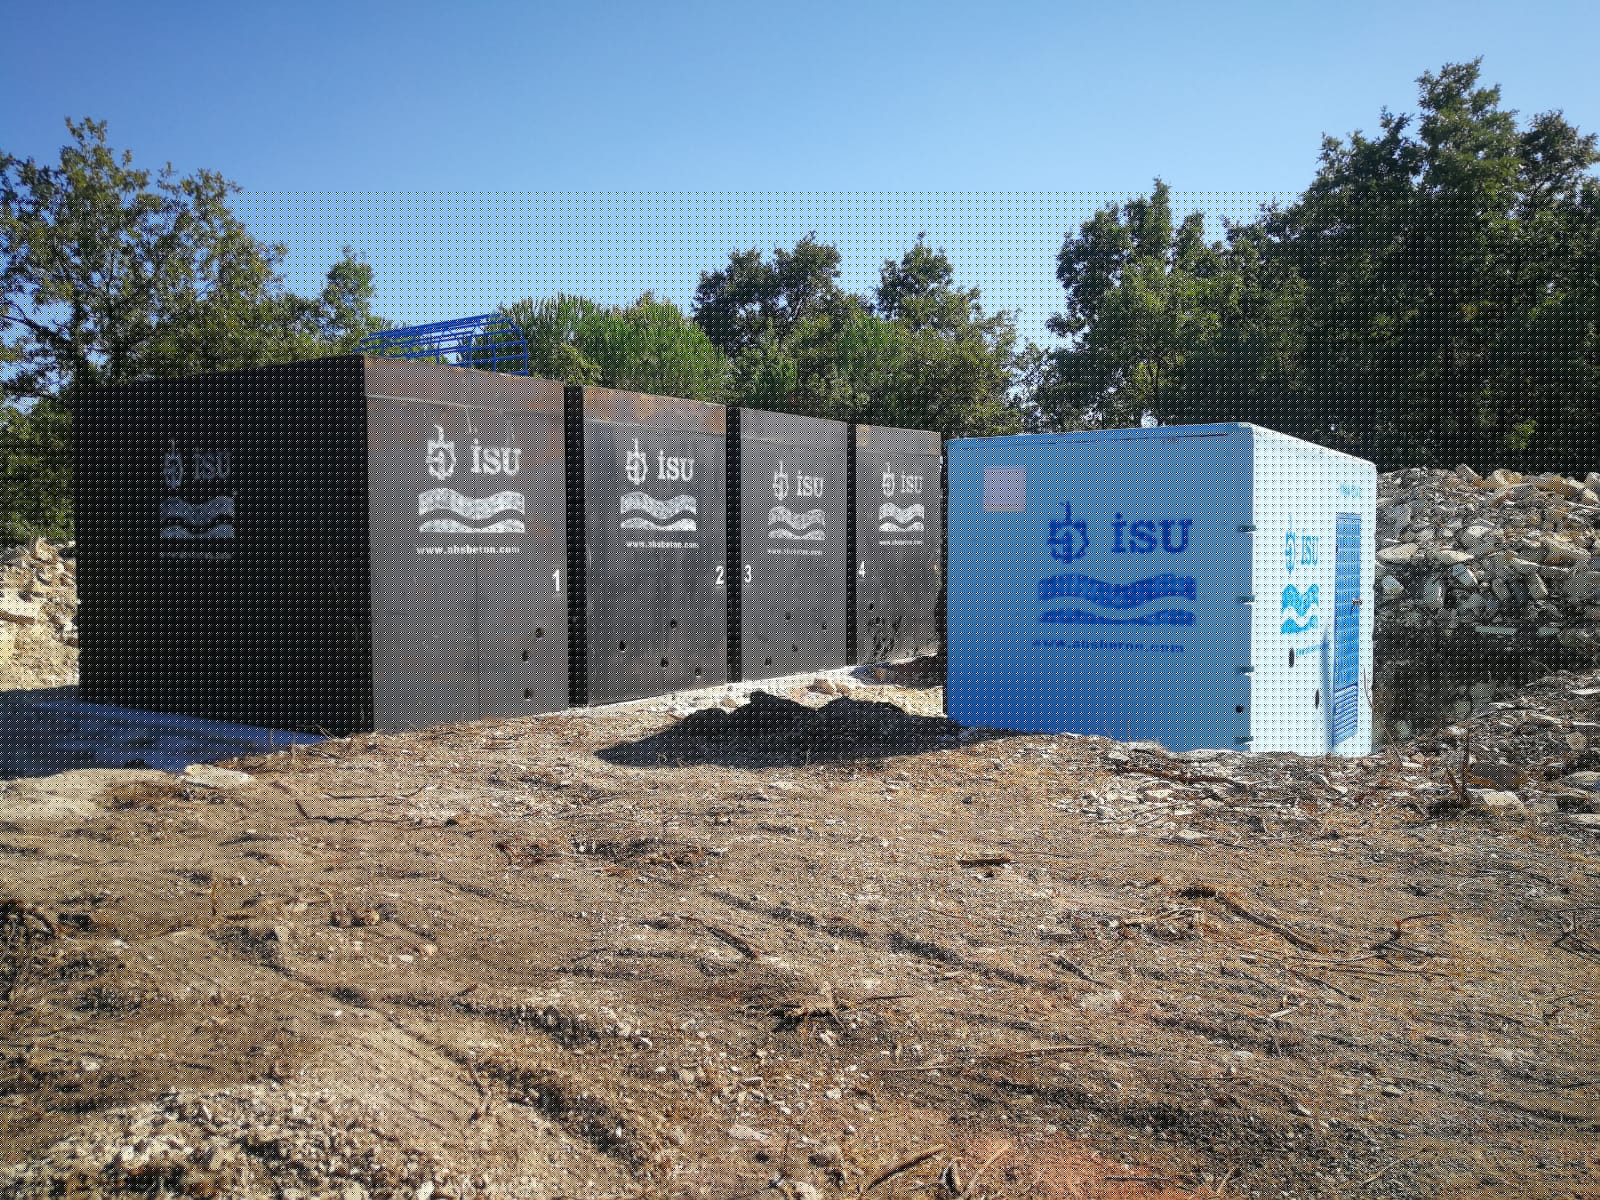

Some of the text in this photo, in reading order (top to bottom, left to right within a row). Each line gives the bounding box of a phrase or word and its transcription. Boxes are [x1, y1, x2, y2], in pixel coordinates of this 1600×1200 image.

[470, 438, 522, 477] İSU
[658, 450, 696, 481] İSU
[1110, 512, 1194, 554] İSU
[552, 569, 561, 592] 1
[715, 565, 725, 585] 2
[744, 564, 752, 583] 3
[858, 560, 866, 578] 4
